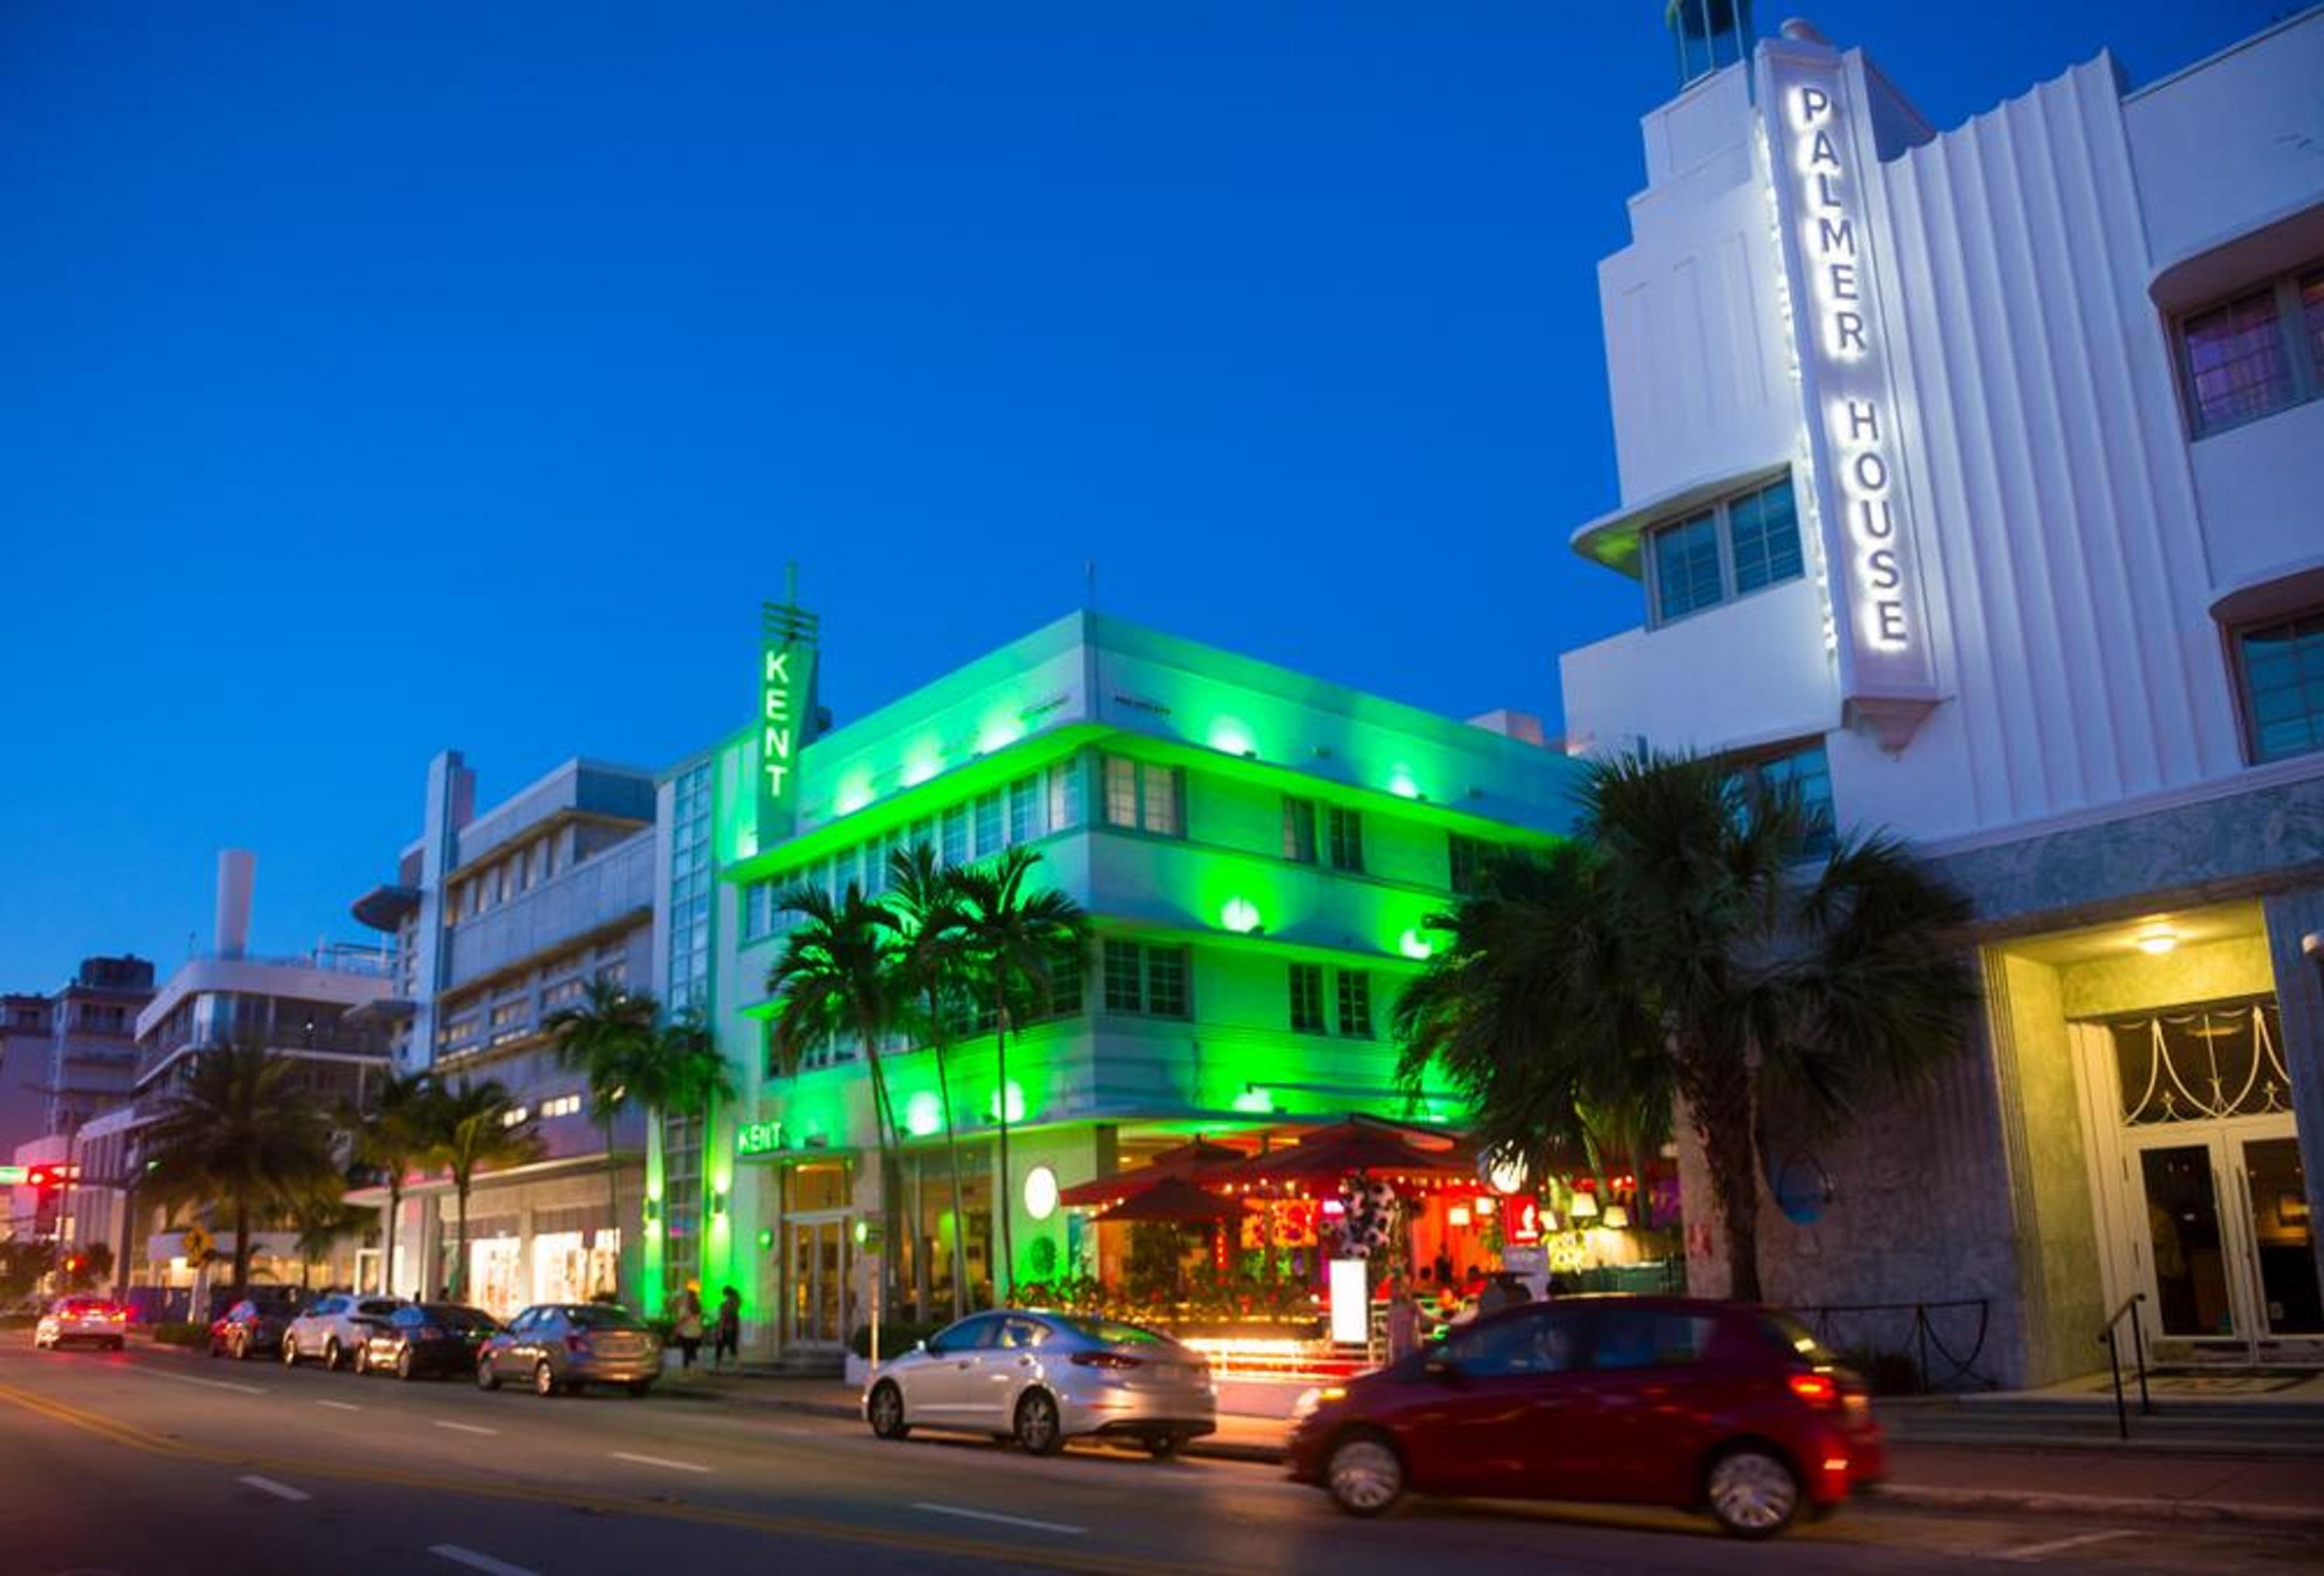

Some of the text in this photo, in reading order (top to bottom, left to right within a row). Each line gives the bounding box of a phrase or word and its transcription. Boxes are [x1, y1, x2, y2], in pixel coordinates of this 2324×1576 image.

[1803, 87, 1907, 642] PALMER HOUSE
[765, 649, 790, 797] KENT
[737, 1121, 782, 1153] KENT
